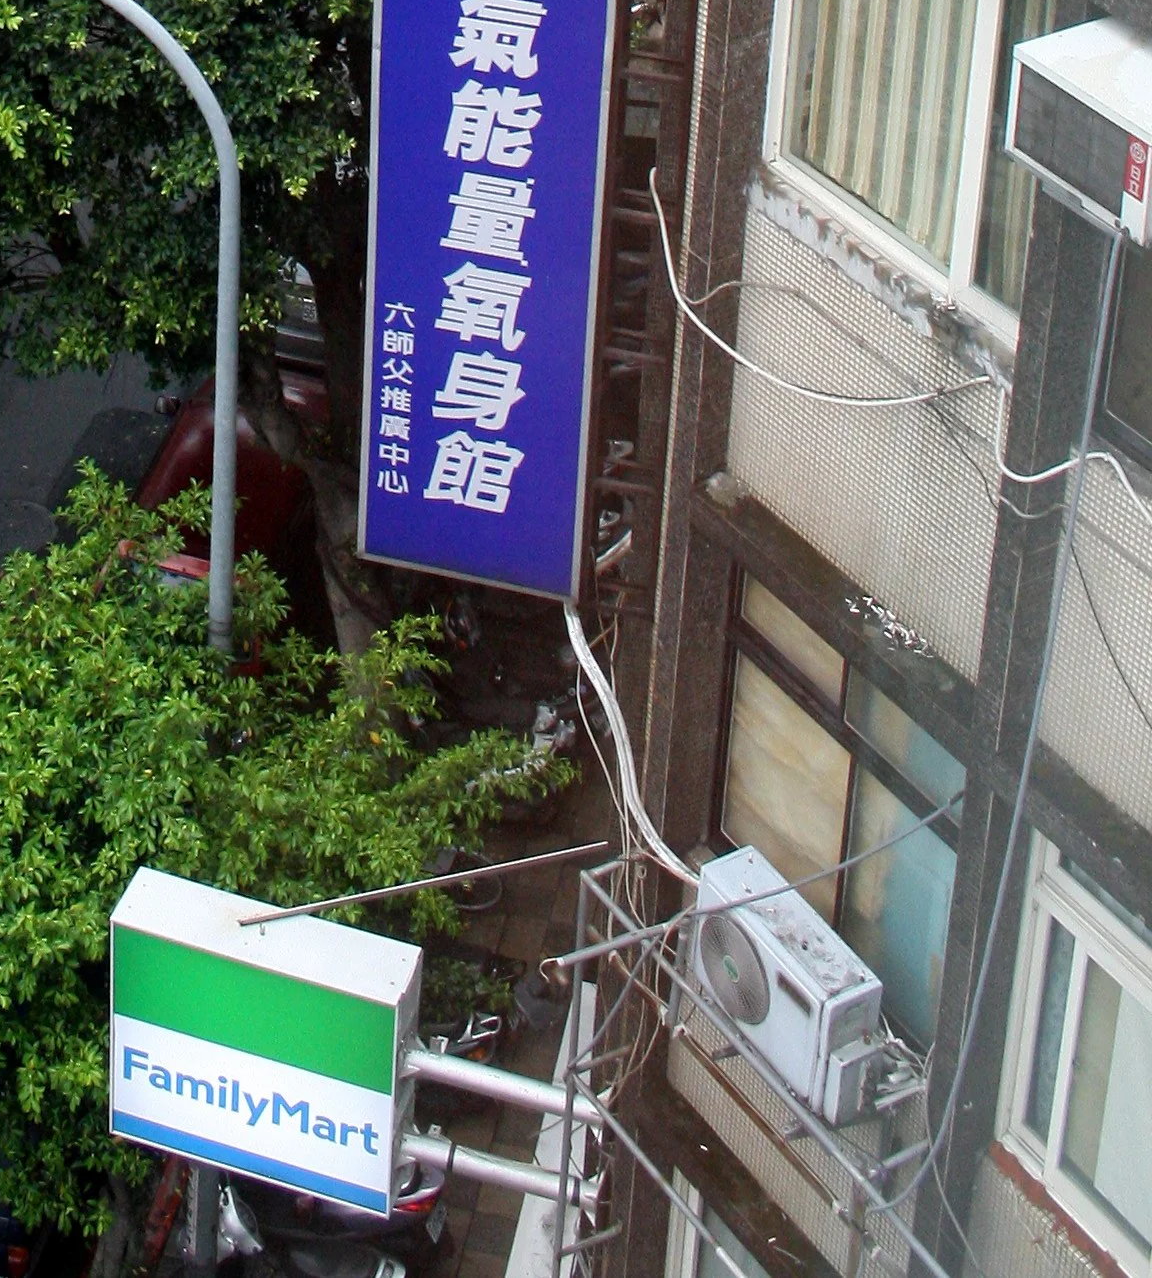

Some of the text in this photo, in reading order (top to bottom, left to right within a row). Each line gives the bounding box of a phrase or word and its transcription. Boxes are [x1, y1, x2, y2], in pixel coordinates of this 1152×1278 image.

[376, 301, 416, 495] 六師父推廣中心
[123, 1045, 380, 1156] FamilyMart
